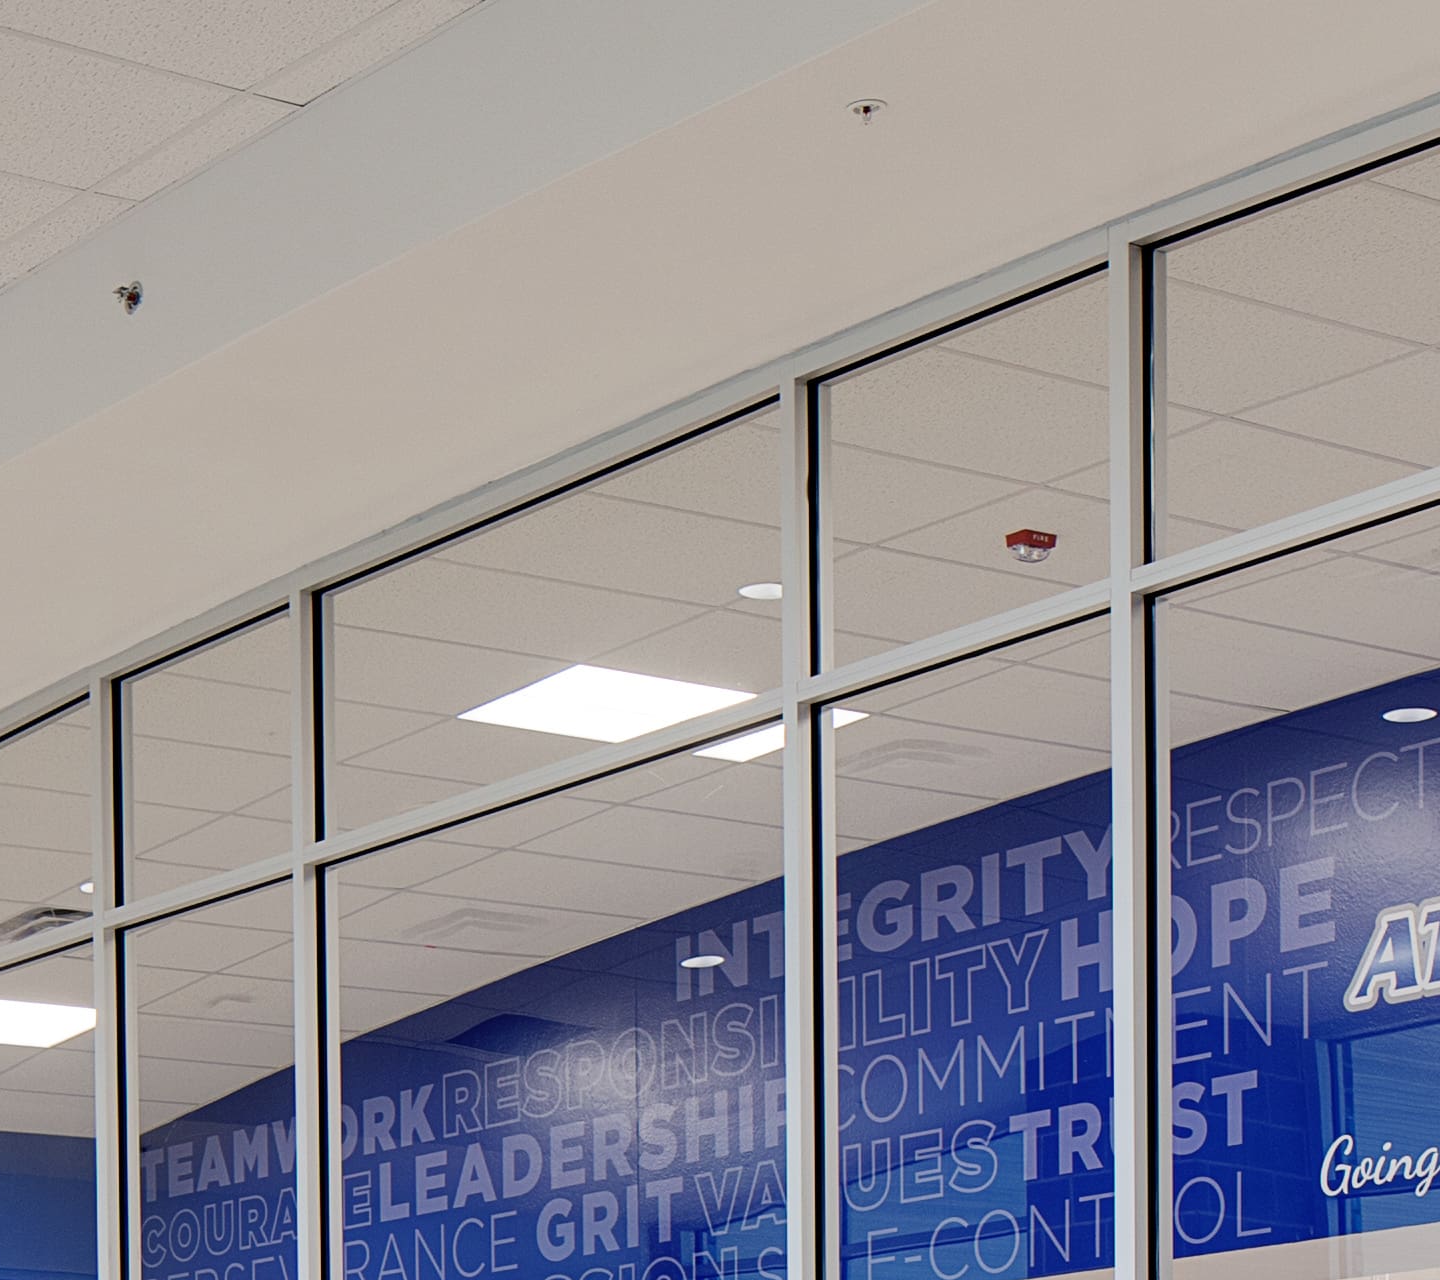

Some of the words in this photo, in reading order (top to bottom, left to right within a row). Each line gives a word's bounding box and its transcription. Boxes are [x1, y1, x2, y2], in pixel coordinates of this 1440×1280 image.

[141, 1170, 371, 1268] COURAE
[837, 961, 1329, 1131] OMMITENT
[442, 928, 1050, 1138] RESPONSIILITY
[536, 1176, 683, 1263] GRIT
[694, 1119, 998, 1237] VAUES
[1009, 1069, 1258, 1182] TRST
